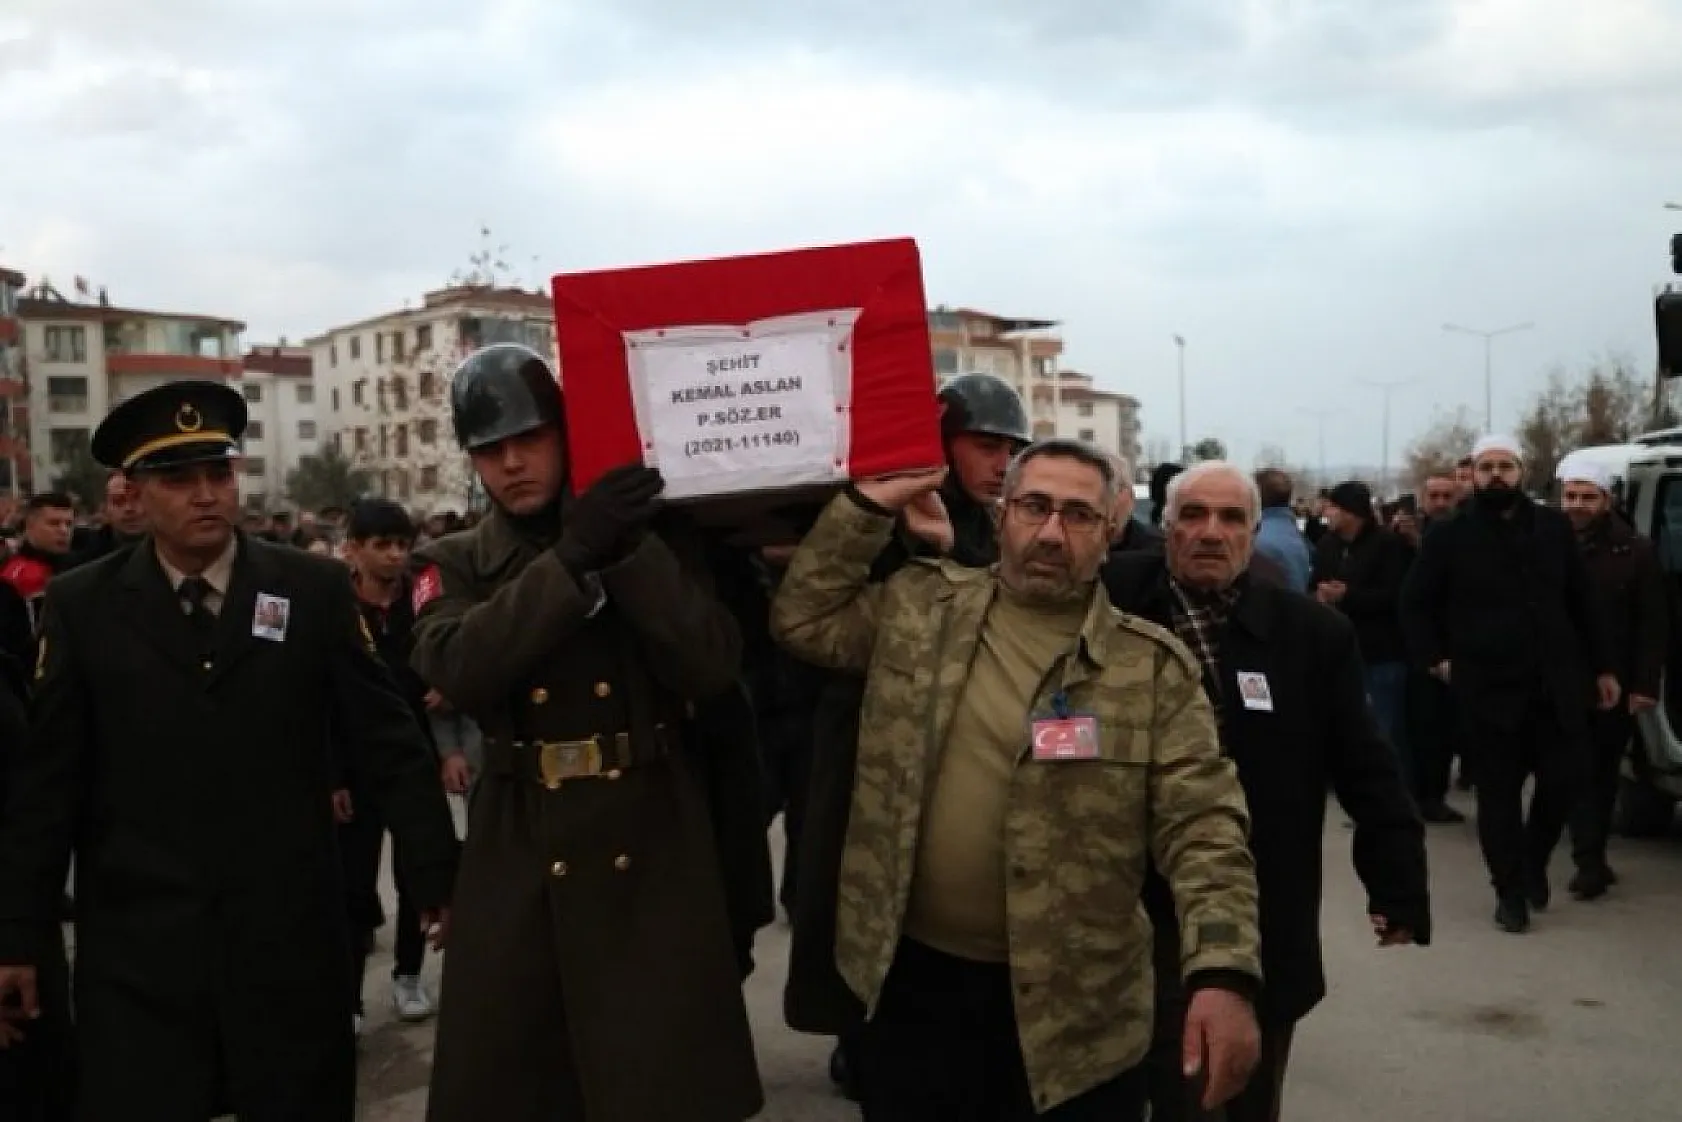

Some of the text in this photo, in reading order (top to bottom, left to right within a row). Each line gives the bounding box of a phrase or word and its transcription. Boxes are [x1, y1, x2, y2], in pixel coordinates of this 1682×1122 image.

[706, 354, 761, 375] ŞEHİT
[671, 376, 803, 405] KEMAL ASLAN
[684, 430, 800, 458] (2021-11140)
